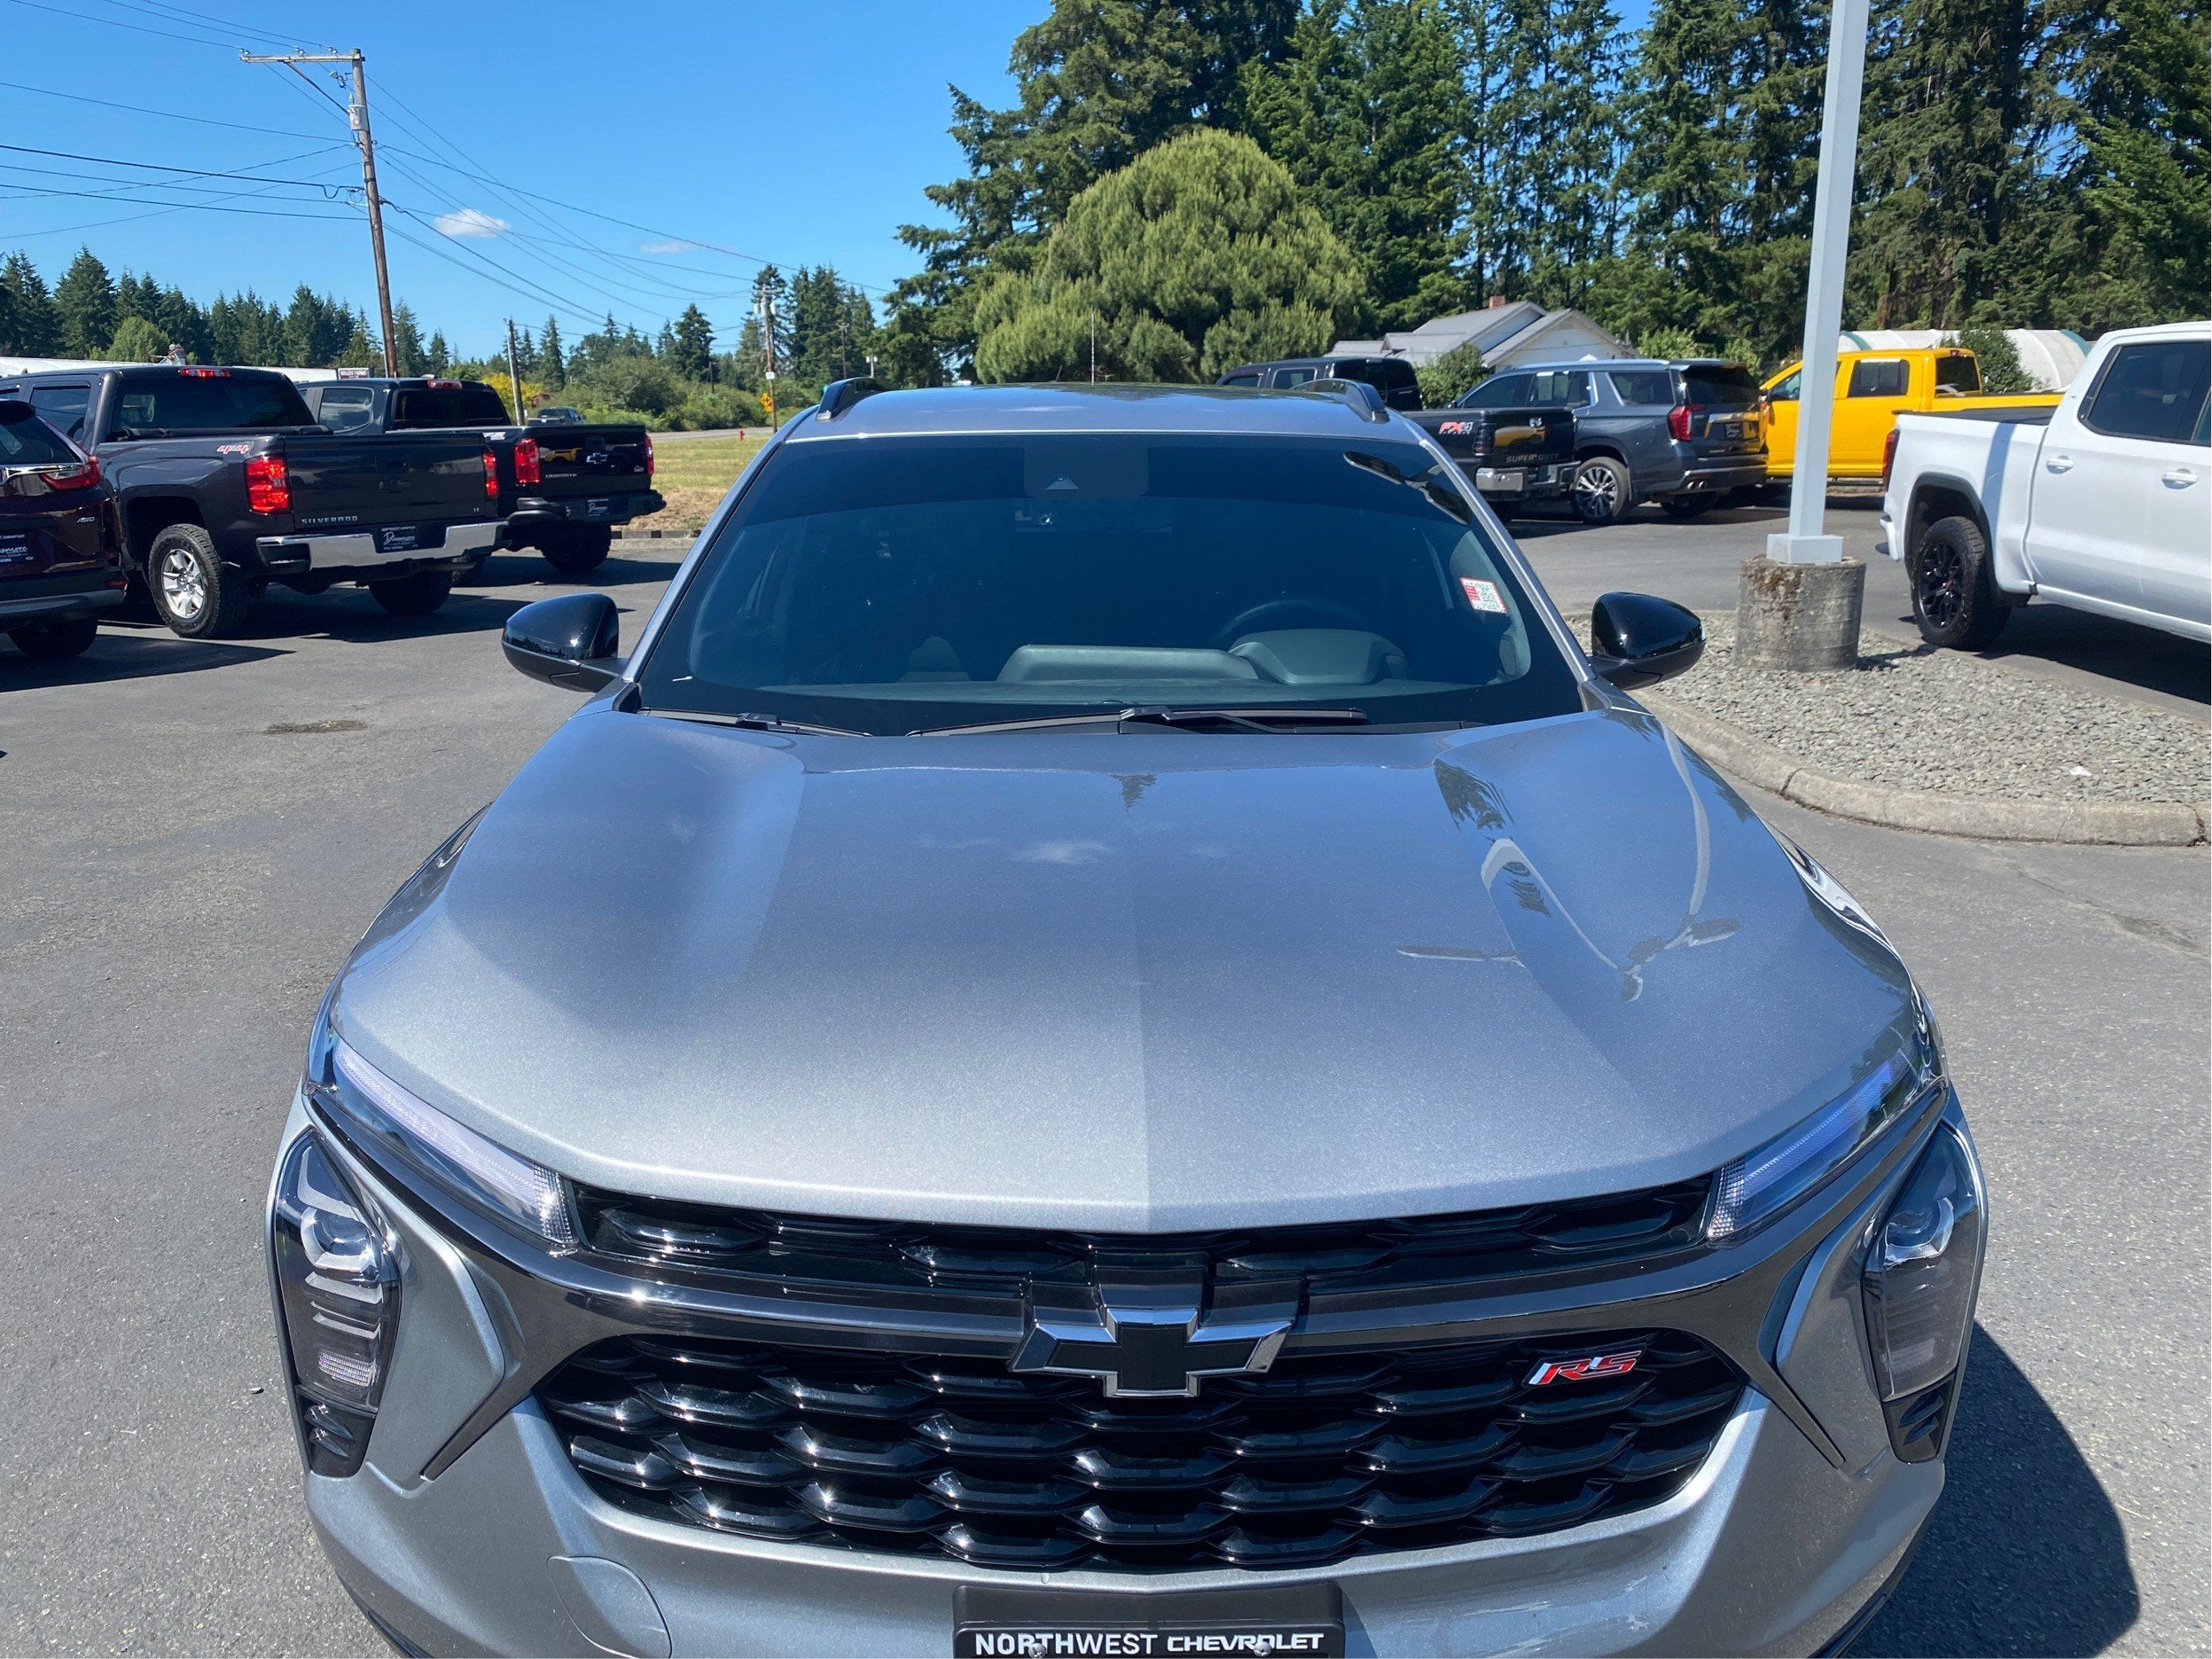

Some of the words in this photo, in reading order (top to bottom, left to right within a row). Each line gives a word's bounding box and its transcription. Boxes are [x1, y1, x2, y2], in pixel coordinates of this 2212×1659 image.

[1438, 421, 1473, 434] FX4
[1506, 454, 1536, 463] SUPER
[301, 515, 358, 524] SILVERADO
[1528, 1350, 1641, 1385] RS
[975, 1632, 1158, 1655] NORTHWEST
[1167, 1633, 1325, 1652] CHEVROLET
